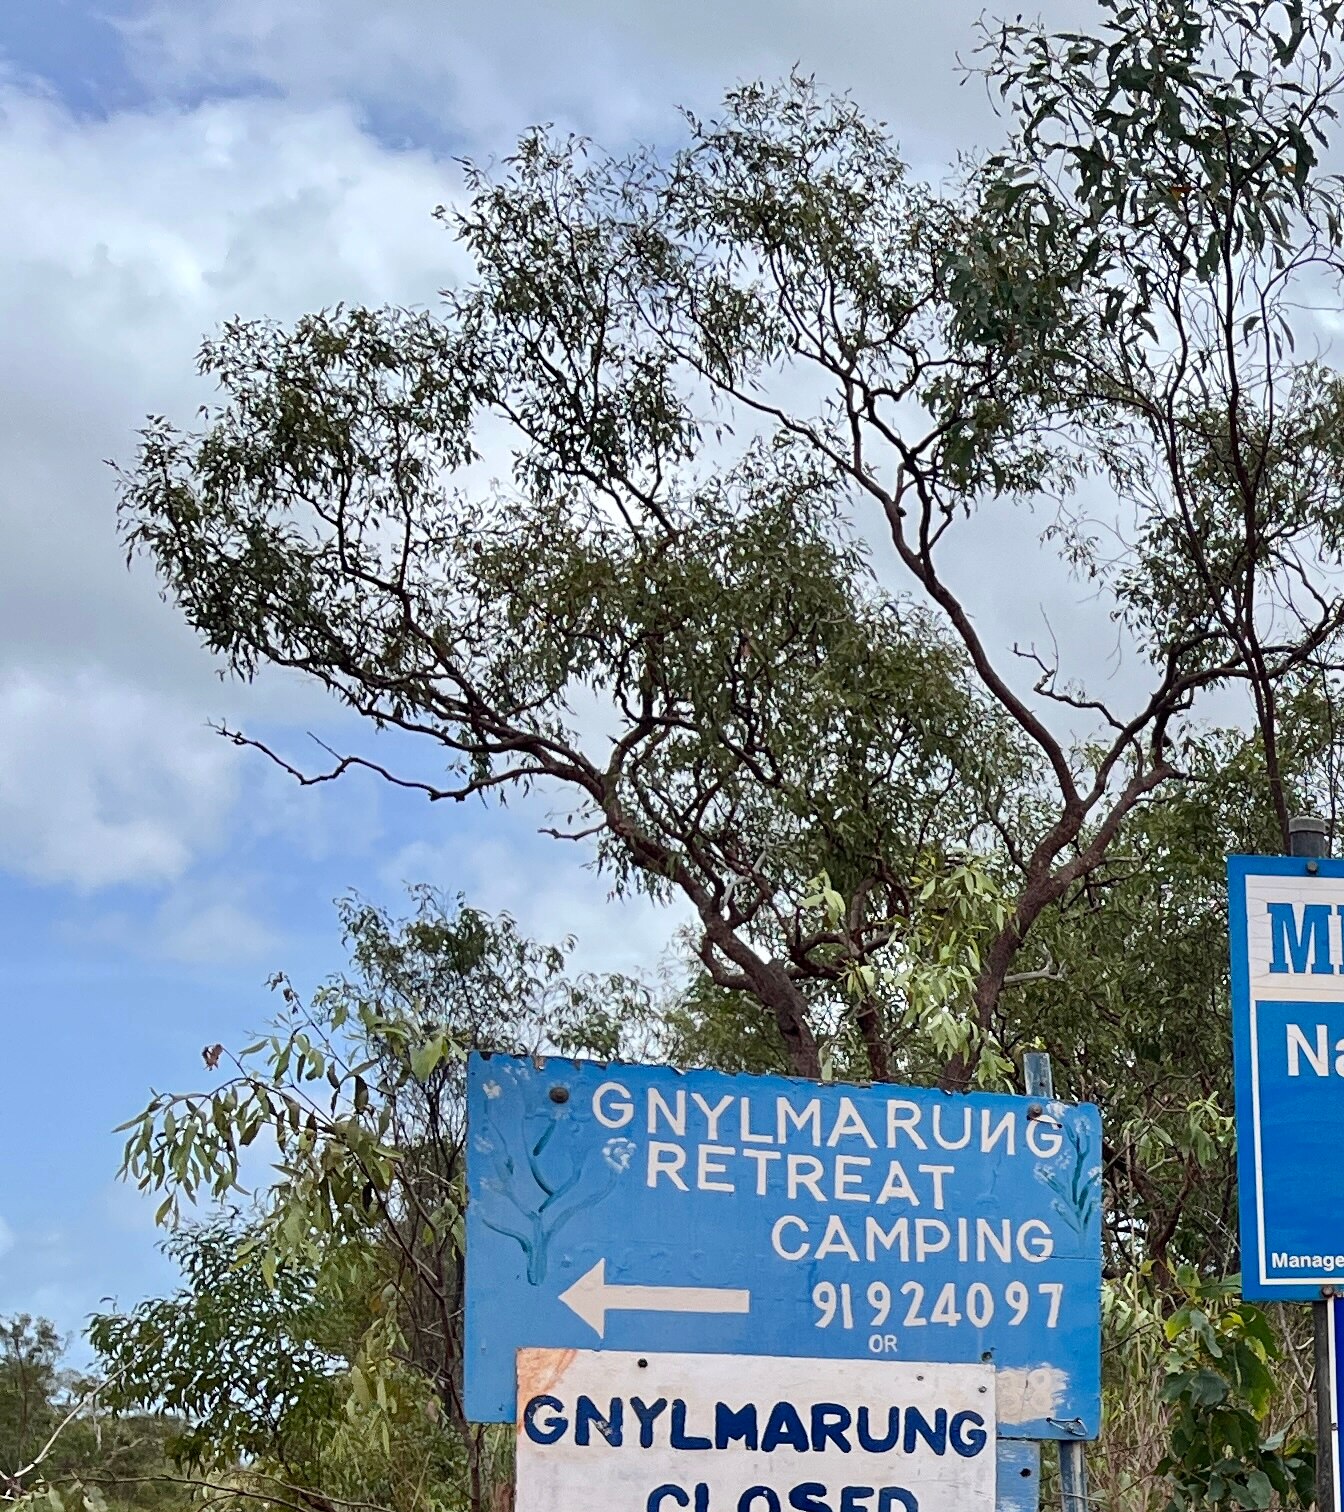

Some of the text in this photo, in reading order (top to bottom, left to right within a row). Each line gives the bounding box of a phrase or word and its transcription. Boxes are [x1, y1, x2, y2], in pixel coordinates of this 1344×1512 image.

[646, 1141, 955, 1211] RETREAT
[771, 1214, 1055, 1264] CAMPING
[868, 1334, 898, 1353] OR
[524, 1394, 988, 1457] GNYLMARUNG
